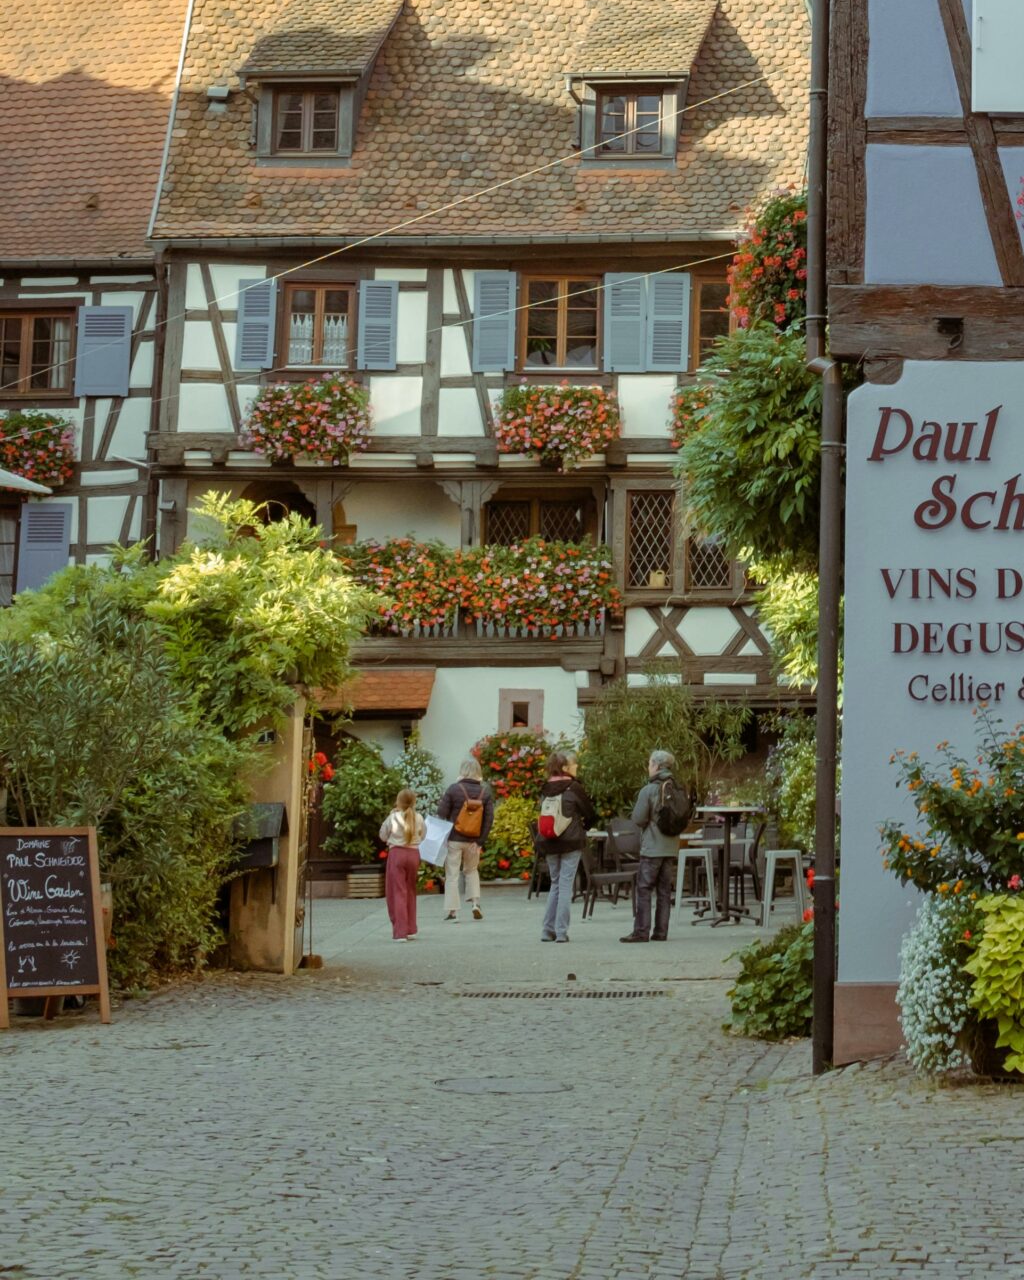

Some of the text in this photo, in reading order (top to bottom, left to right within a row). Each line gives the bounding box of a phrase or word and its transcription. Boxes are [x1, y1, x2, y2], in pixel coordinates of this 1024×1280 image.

[866, 404, 1003, 462] Paul
[880, 567, 978, 600] VINS
[907, 672, 1006, 704] Cellier
[6, 853, 33, 869] PAUL
[7, 874, 84, 902] Wine Garden
